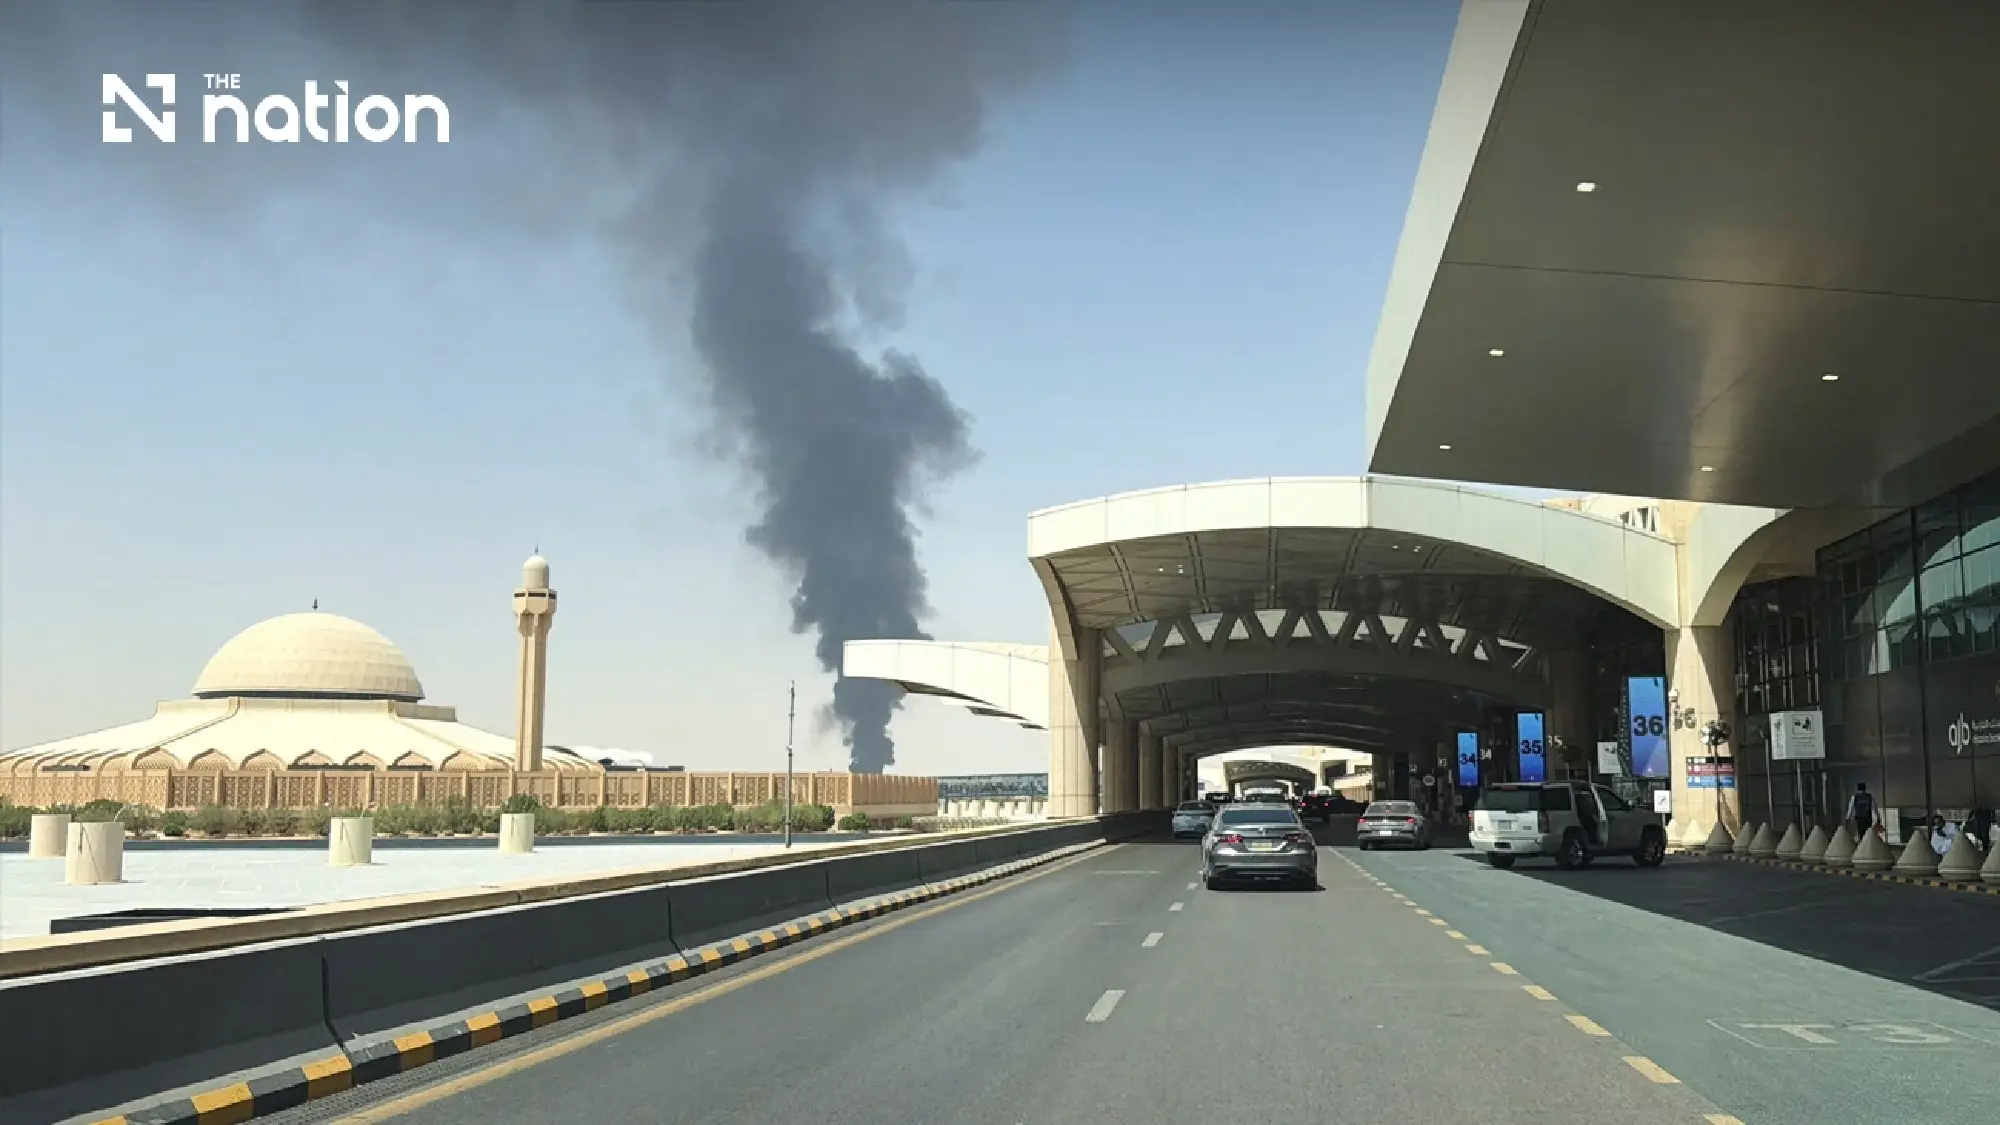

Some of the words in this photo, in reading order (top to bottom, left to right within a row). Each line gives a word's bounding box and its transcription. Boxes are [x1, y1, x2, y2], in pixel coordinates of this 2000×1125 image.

[1633, 715, 1664, 737] 36
[1521, 739, 1541, 755] 35
[1460, 753, 1476, 766] 34
